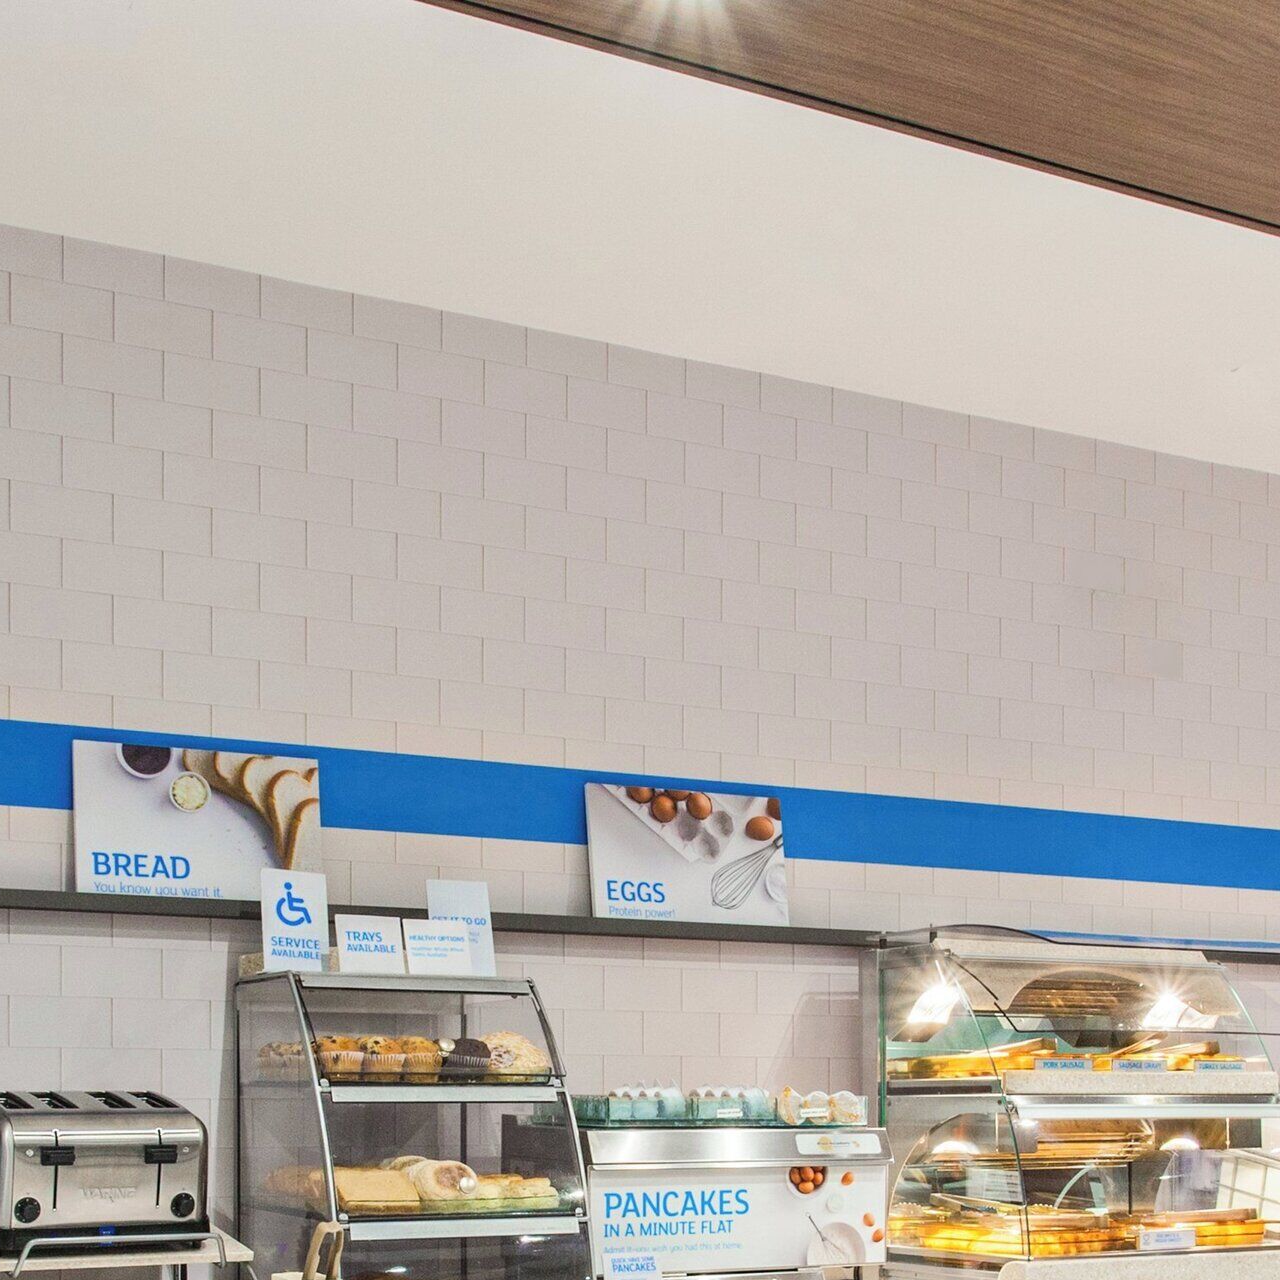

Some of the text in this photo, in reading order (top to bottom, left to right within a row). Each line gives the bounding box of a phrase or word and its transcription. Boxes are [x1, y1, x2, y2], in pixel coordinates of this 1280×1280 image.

[92, 851, 191, 880] BREAD
[93, 881, 224, 898] You know you want it.
[606, 880, 666, 904] EGGS
[608, 905, 643, 917] Protein
[475, 917, 487, 926] GO
[345, 930, 383, 943] TRAYS
[271, 936, 320, 950] SERVICE
[346, 943, 397, 954] AVAILABLE
[271, 949, 320, 960] AVAILABLE
[1042, 1061, 1085, 1069] PORK SAUSAGE
[1118, 1061, 1143, 1069] SAUSAGE
[604, 1189, 750, 1218] PANCAKES
[604, 1219, 734, 1238] IN A MINUTE FLAT
[612, 1261, 657, 1273] PANCAKES
